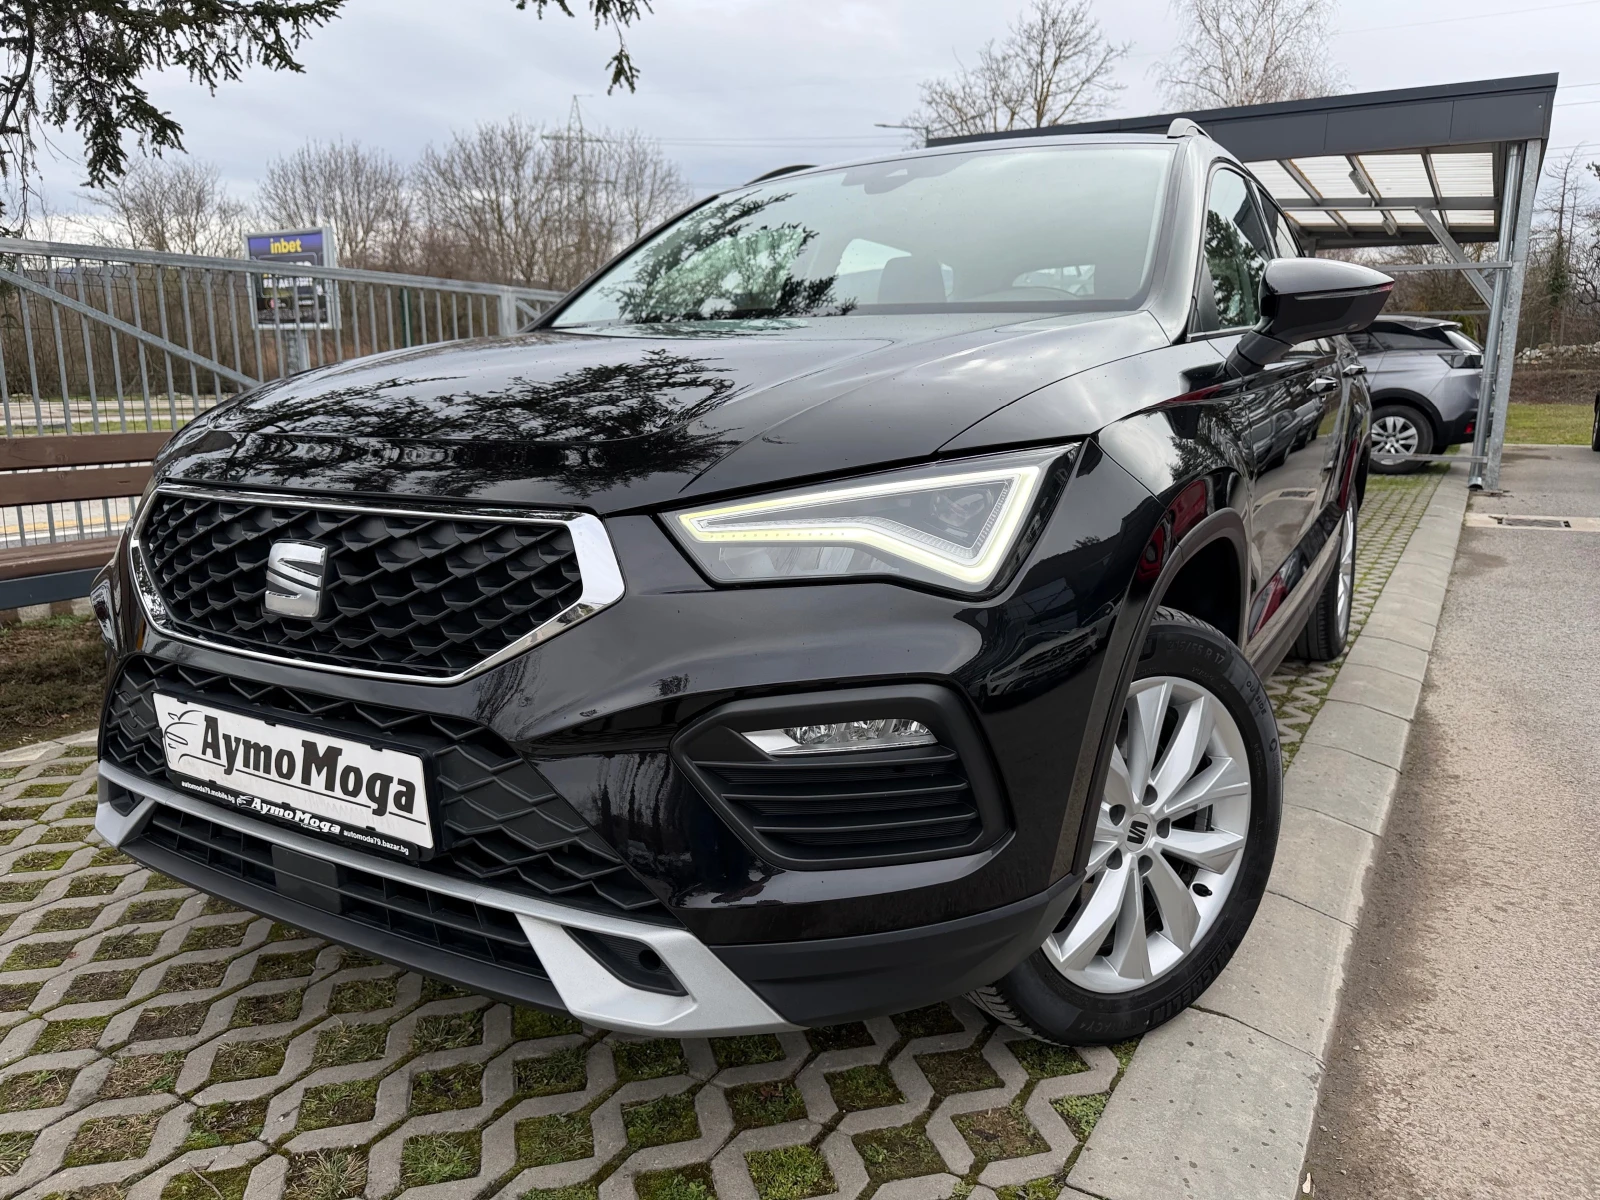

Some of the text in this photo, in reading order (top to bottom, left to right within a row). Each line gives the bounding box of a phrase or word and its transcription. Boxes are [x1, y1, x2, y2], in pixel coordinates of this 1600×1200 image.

[270, 238, 302, 253] inbet
[1214, 652, 1226, 665] 17
[343, 829, 409, 856] automoda79.bazar.bg
[1150, 943, 1232, 1025] MICHELIN
